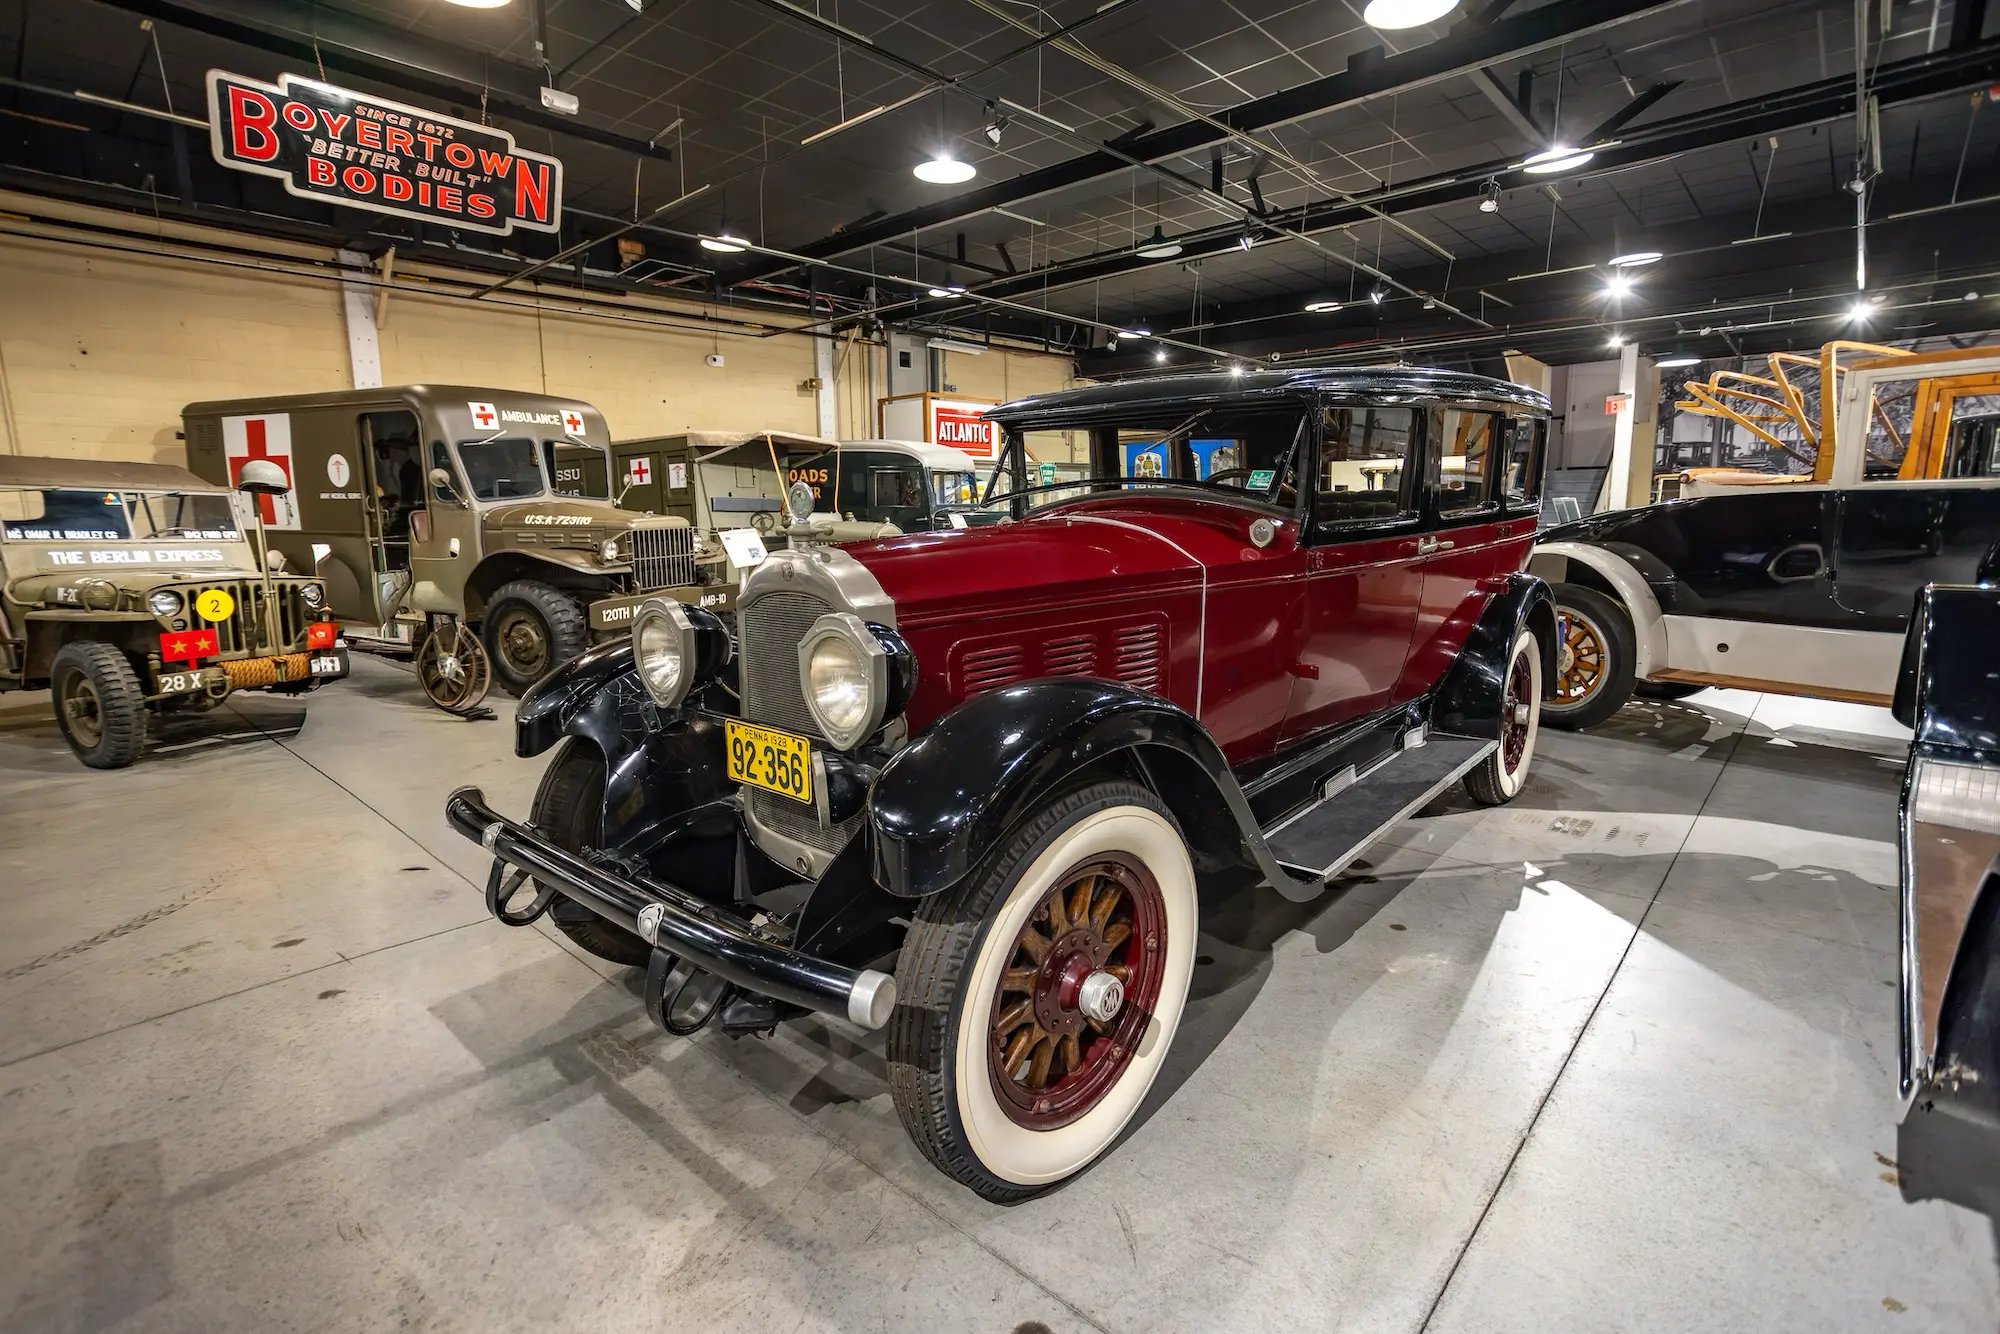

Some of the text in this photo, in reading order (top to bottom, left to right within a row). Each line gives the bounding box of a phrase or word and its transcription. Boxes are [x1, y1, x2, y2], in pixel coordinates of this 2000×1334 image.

[354, 105, 454, 140] SINCE 1872
[228, 84, 549, 223] BOYERTOWN
[307, 155, 496, 218] BODIES
[501, 410, 562, 426] AMBULANCE
[939, 421, 990, 444] ATLANTIC
[556, 468, 581, 481] SSU
[789, 469, 829, 482] OADS
[24, 530, 51, 539] OMAR
[48, 550, 224, 565] THE BERLIN EXPRESS
[210, 599, 220, 613] 2
[700, 593, 727, 607] AMB-10
[602, 605, 630, 622] 120TH
[161, 672, 202, 692] 28 X
[744, 728, 787, 747] PENNA 1928
